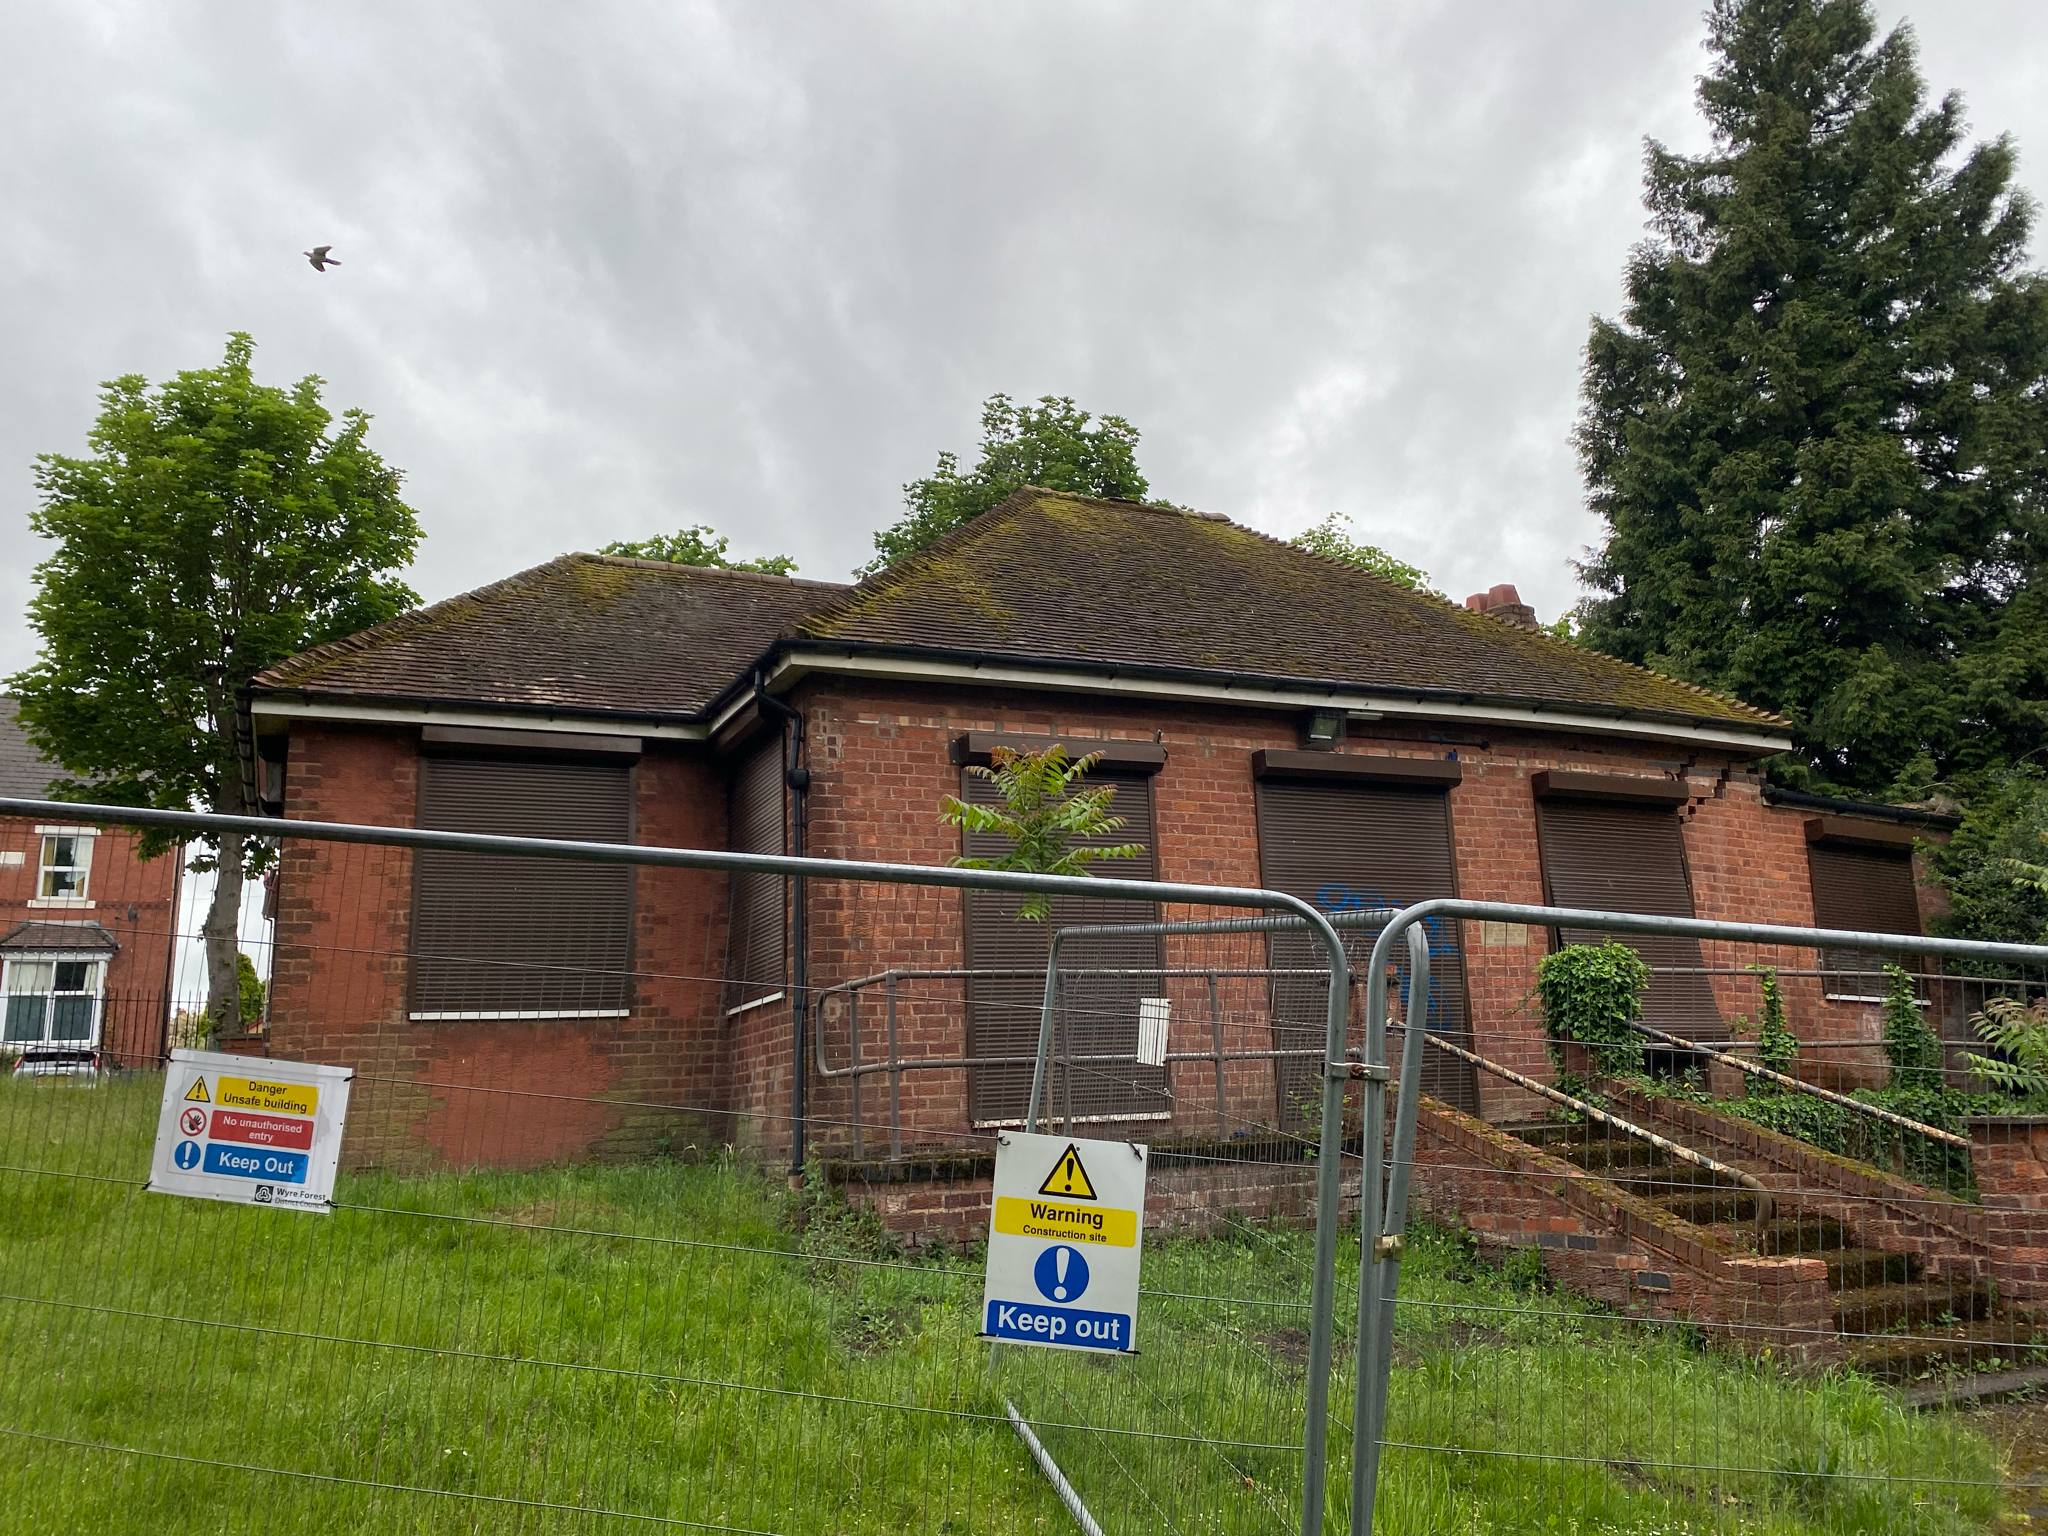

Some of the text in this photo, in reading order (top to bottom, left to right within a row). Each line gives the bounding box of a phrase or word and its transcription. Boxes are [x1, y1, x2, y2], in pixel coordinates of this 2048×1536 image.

[249, 1081, 287, 1095] Danger
[223, 1092, 308, 1114] Unsafe building
[223, 1115, 303, 1134] No unauthorised
[248, 1132, 274, 1143] entry
[219, 1151, 294, 1175] Keep Out
[276, 1187, 326, 1201] Wyre Forest
[1030, 1203, 1104, 1229] Warning
[1023, 1224, 1107, 1243] Construction site
[998, 1305, 1121, 1341] Keep out
